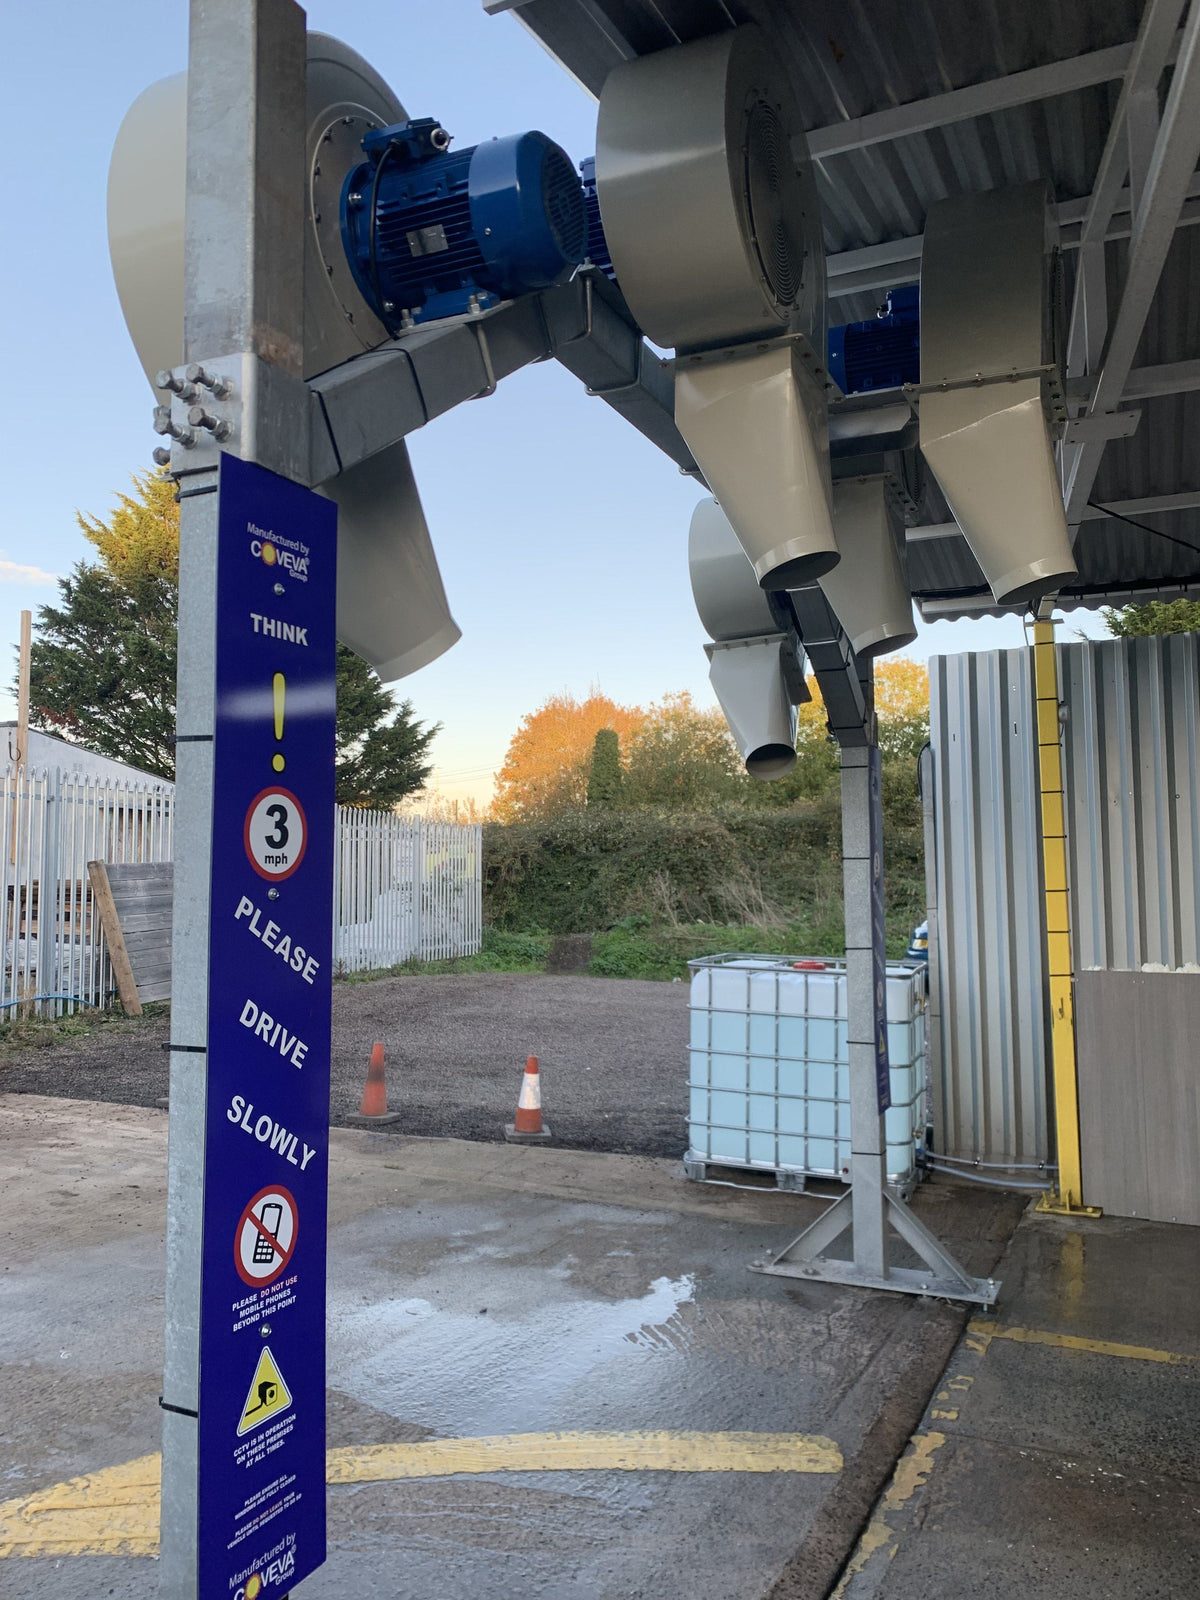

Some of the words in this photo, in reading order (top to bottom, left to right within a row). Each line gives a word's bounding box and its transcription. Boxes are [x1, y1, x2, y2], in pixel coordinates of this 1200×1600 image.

[247, 522, 299, 550] Manufactured
[300, 542, 309, 556] by
[289, 569, 308, 582] Group
[250, 613, 308, 646] THINK
[264, 804, 289, 850] 3
[264, 853, 288, 867] mph
[234, 895, 320, 985] PLEASE
[239, 999, 308, 1069] DRIVE
[226, 1095, 316, 1171] SLOWLY
[232, 1294, 257, 1311] PLEASE
[260, 1289, 269, 1298] DO
[271, 1282, 284, 1293] NOT
[285, 1275, 298, 1286] USE
[240, 1301, 264, 1318] MOBILE
[266, 1288, 291, 1306] PHONES
[233, 1313, 260, 1332] BEYOND
[261, 1305, 276, 1317] THIS
[277, 1295, 296, 1310] POINT
[234, 1442, 250, 1457] CCTV
[250, 1438, 257, 1446] IS
[258, 1433, 264, 1442] IN
[265, 1413, 296, 1437] OPERATION
[237, 1454, 245, 1464] ON
[247, 1441, 265, 1457] THESE
[266, 1424, 294, 1446] PREMISES
[246, 1458, 254, 1469] AT
[254, 1451, 266, 1463] ALL
[245, 1491, 261, 1507] PLEASE
[235, 1522, 252, 1538] PLEASE
[229, 1538, 285, 1590] Manufactured
[286, 1532, 296, 1546] by
[275, 1566, 295, 1586] Group
